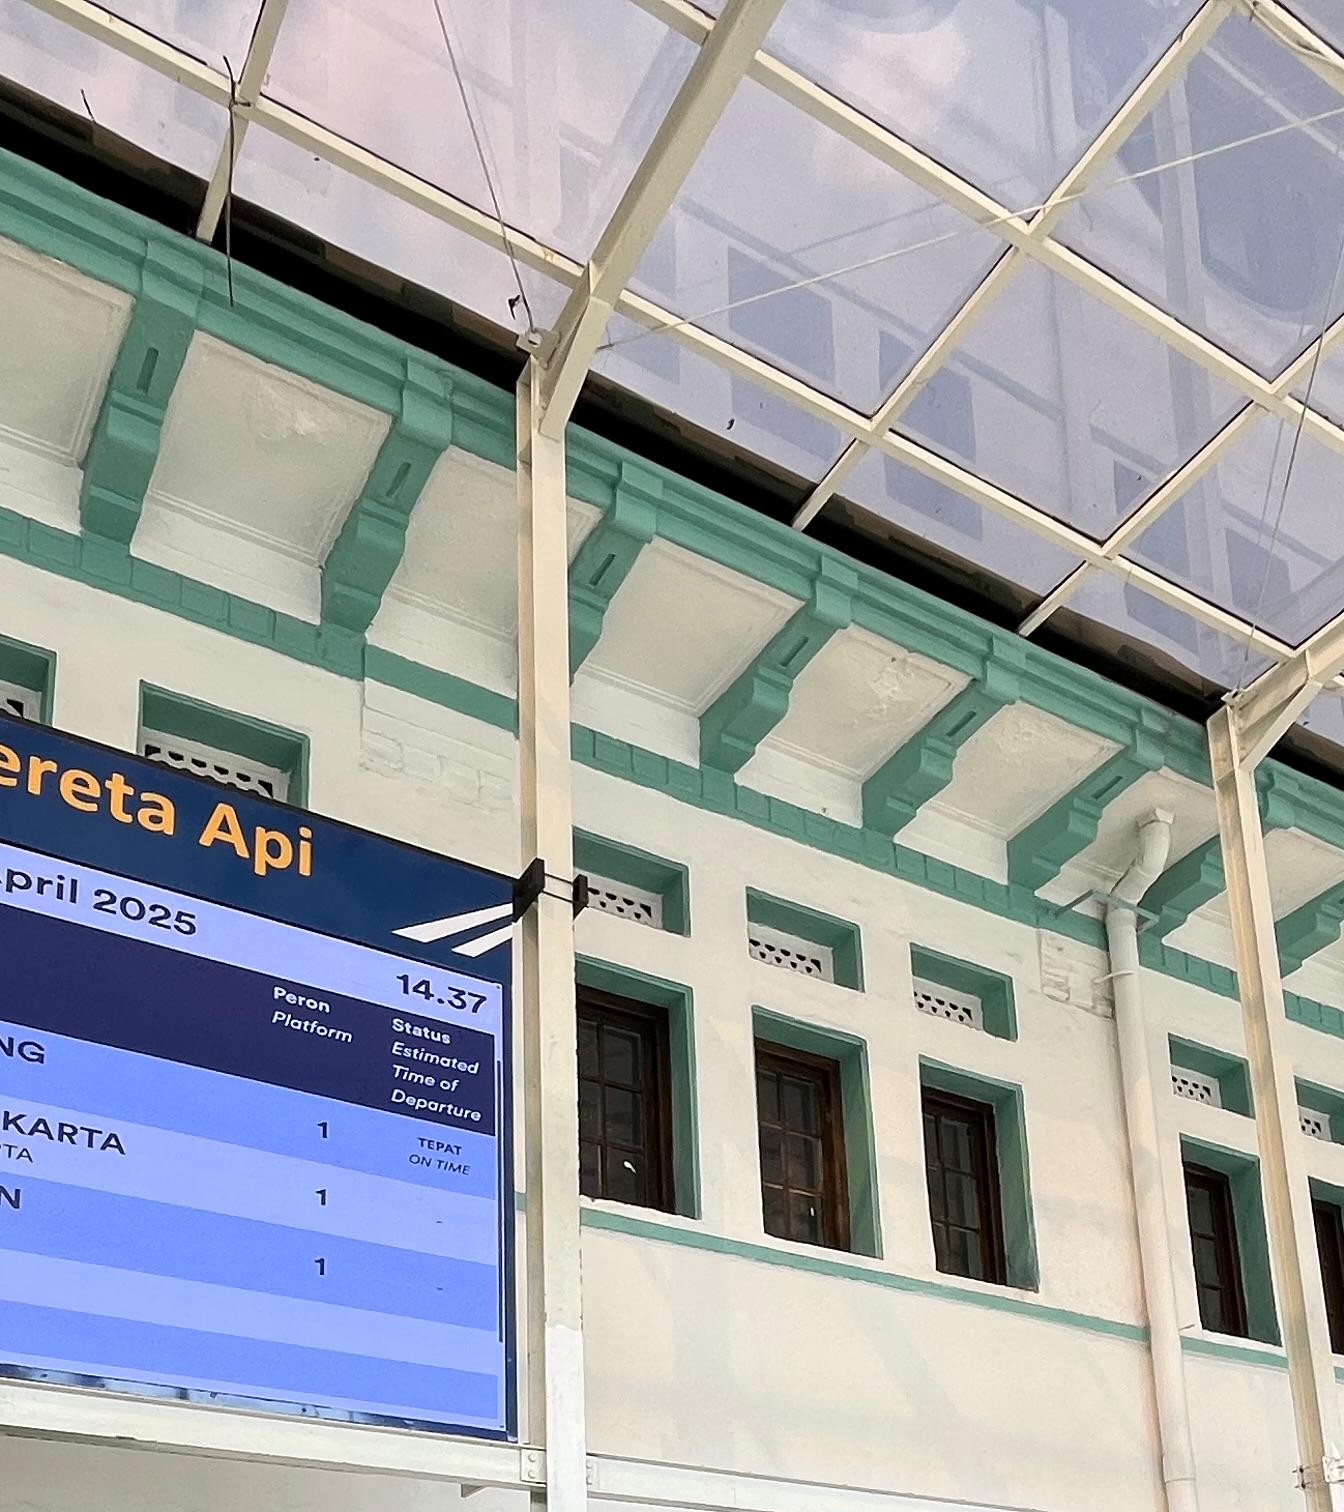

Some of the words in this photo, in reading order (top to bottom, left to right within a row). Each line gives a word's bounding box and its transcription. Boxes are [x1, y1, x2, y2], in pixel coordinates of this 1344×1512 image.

[198, 803, 314, 877] Api
[93, 888, 198, 937] 2025
[273, 985, 331, 1014] Peron
[396, 973, 488, 1015] 14.37
[272, 1010, 354, 1044] Platform
[392, 1017, 452, 1046] Status
[391, 1041, 480, 1076] Estimated
[392, 1065, 433, 1090] Time
[437, 1074, 459, 1093] of
[391, 1088, 482, 1122] Departure
[317, 1120, 328, 1140] 1
[417, 1136, 462, 1156] TEPAT
[409, 1153, 432, 1169] ON
[435, 1157, 470, 1176] TIME
[316, 1188, 328, 1207] 1
[315, 1257, 327, 1276] 1
